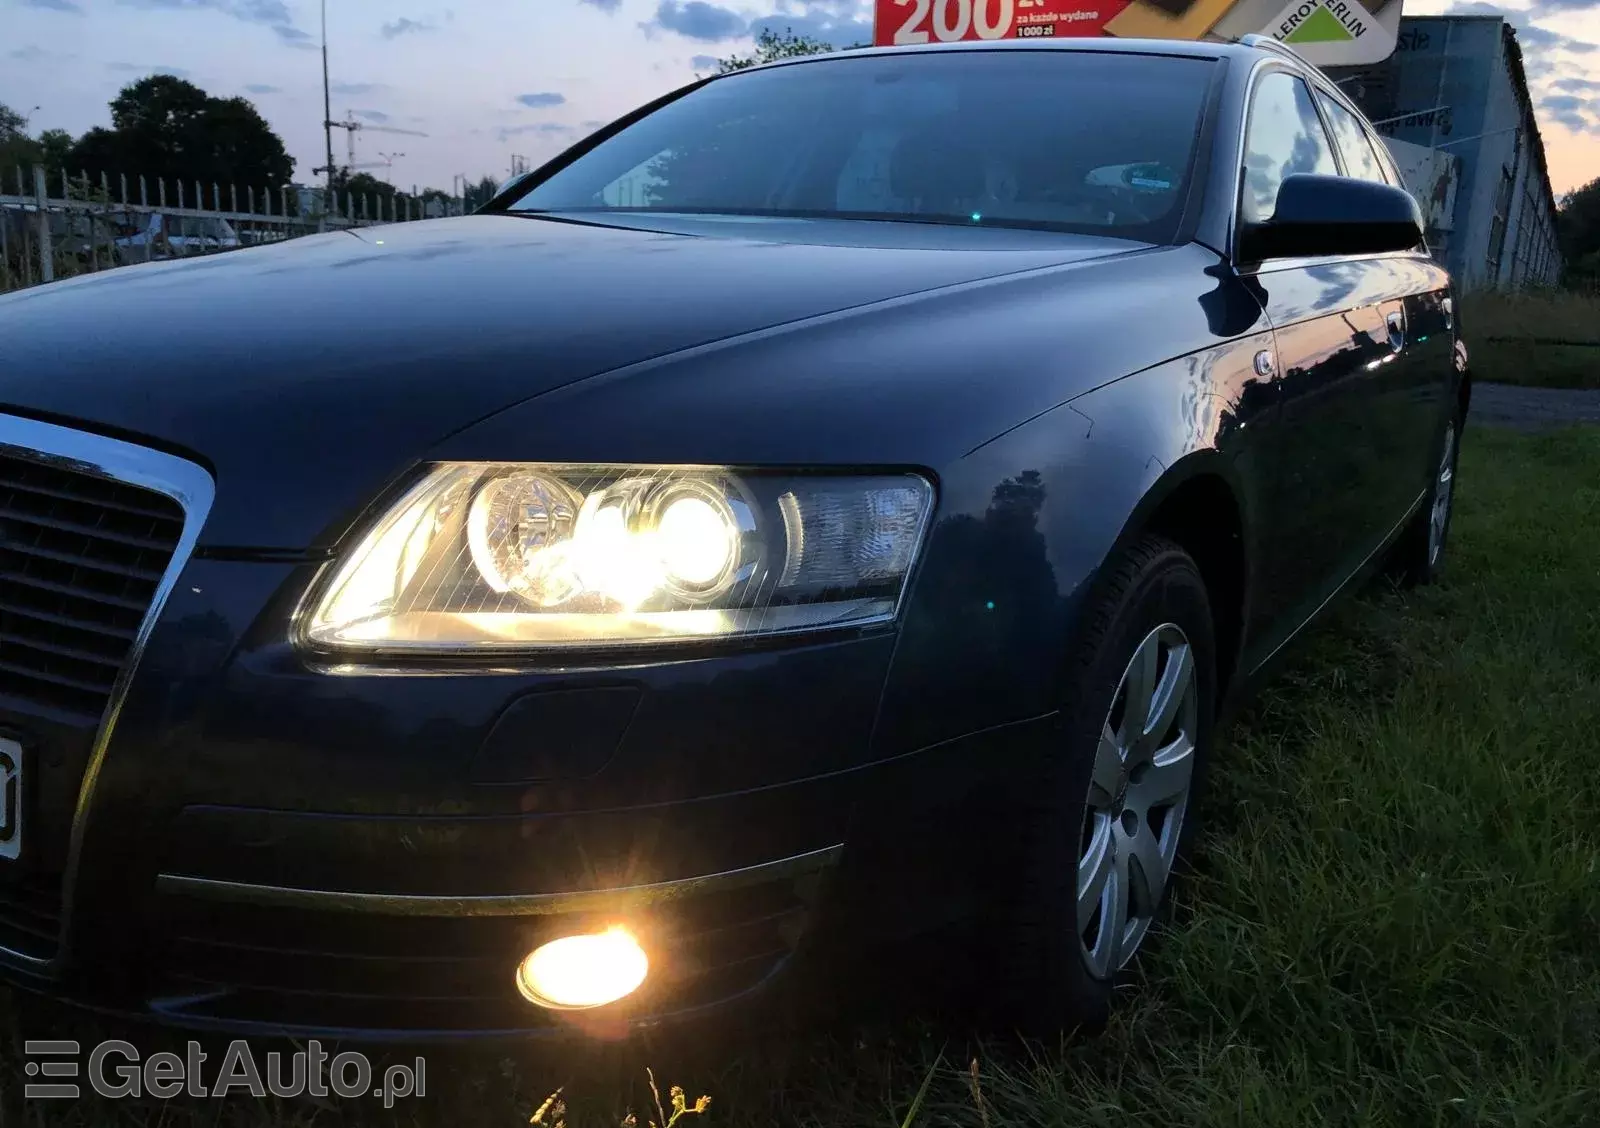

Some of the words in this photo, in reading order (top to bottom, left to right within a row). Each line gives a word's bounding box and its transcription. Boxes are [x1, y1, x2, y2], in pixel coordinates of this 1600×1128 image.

[894, 0, 1014, 45] 200
[1272, 0, 1319, 41] LEROY
[1325, 0, 1367, 38] ERLIN
